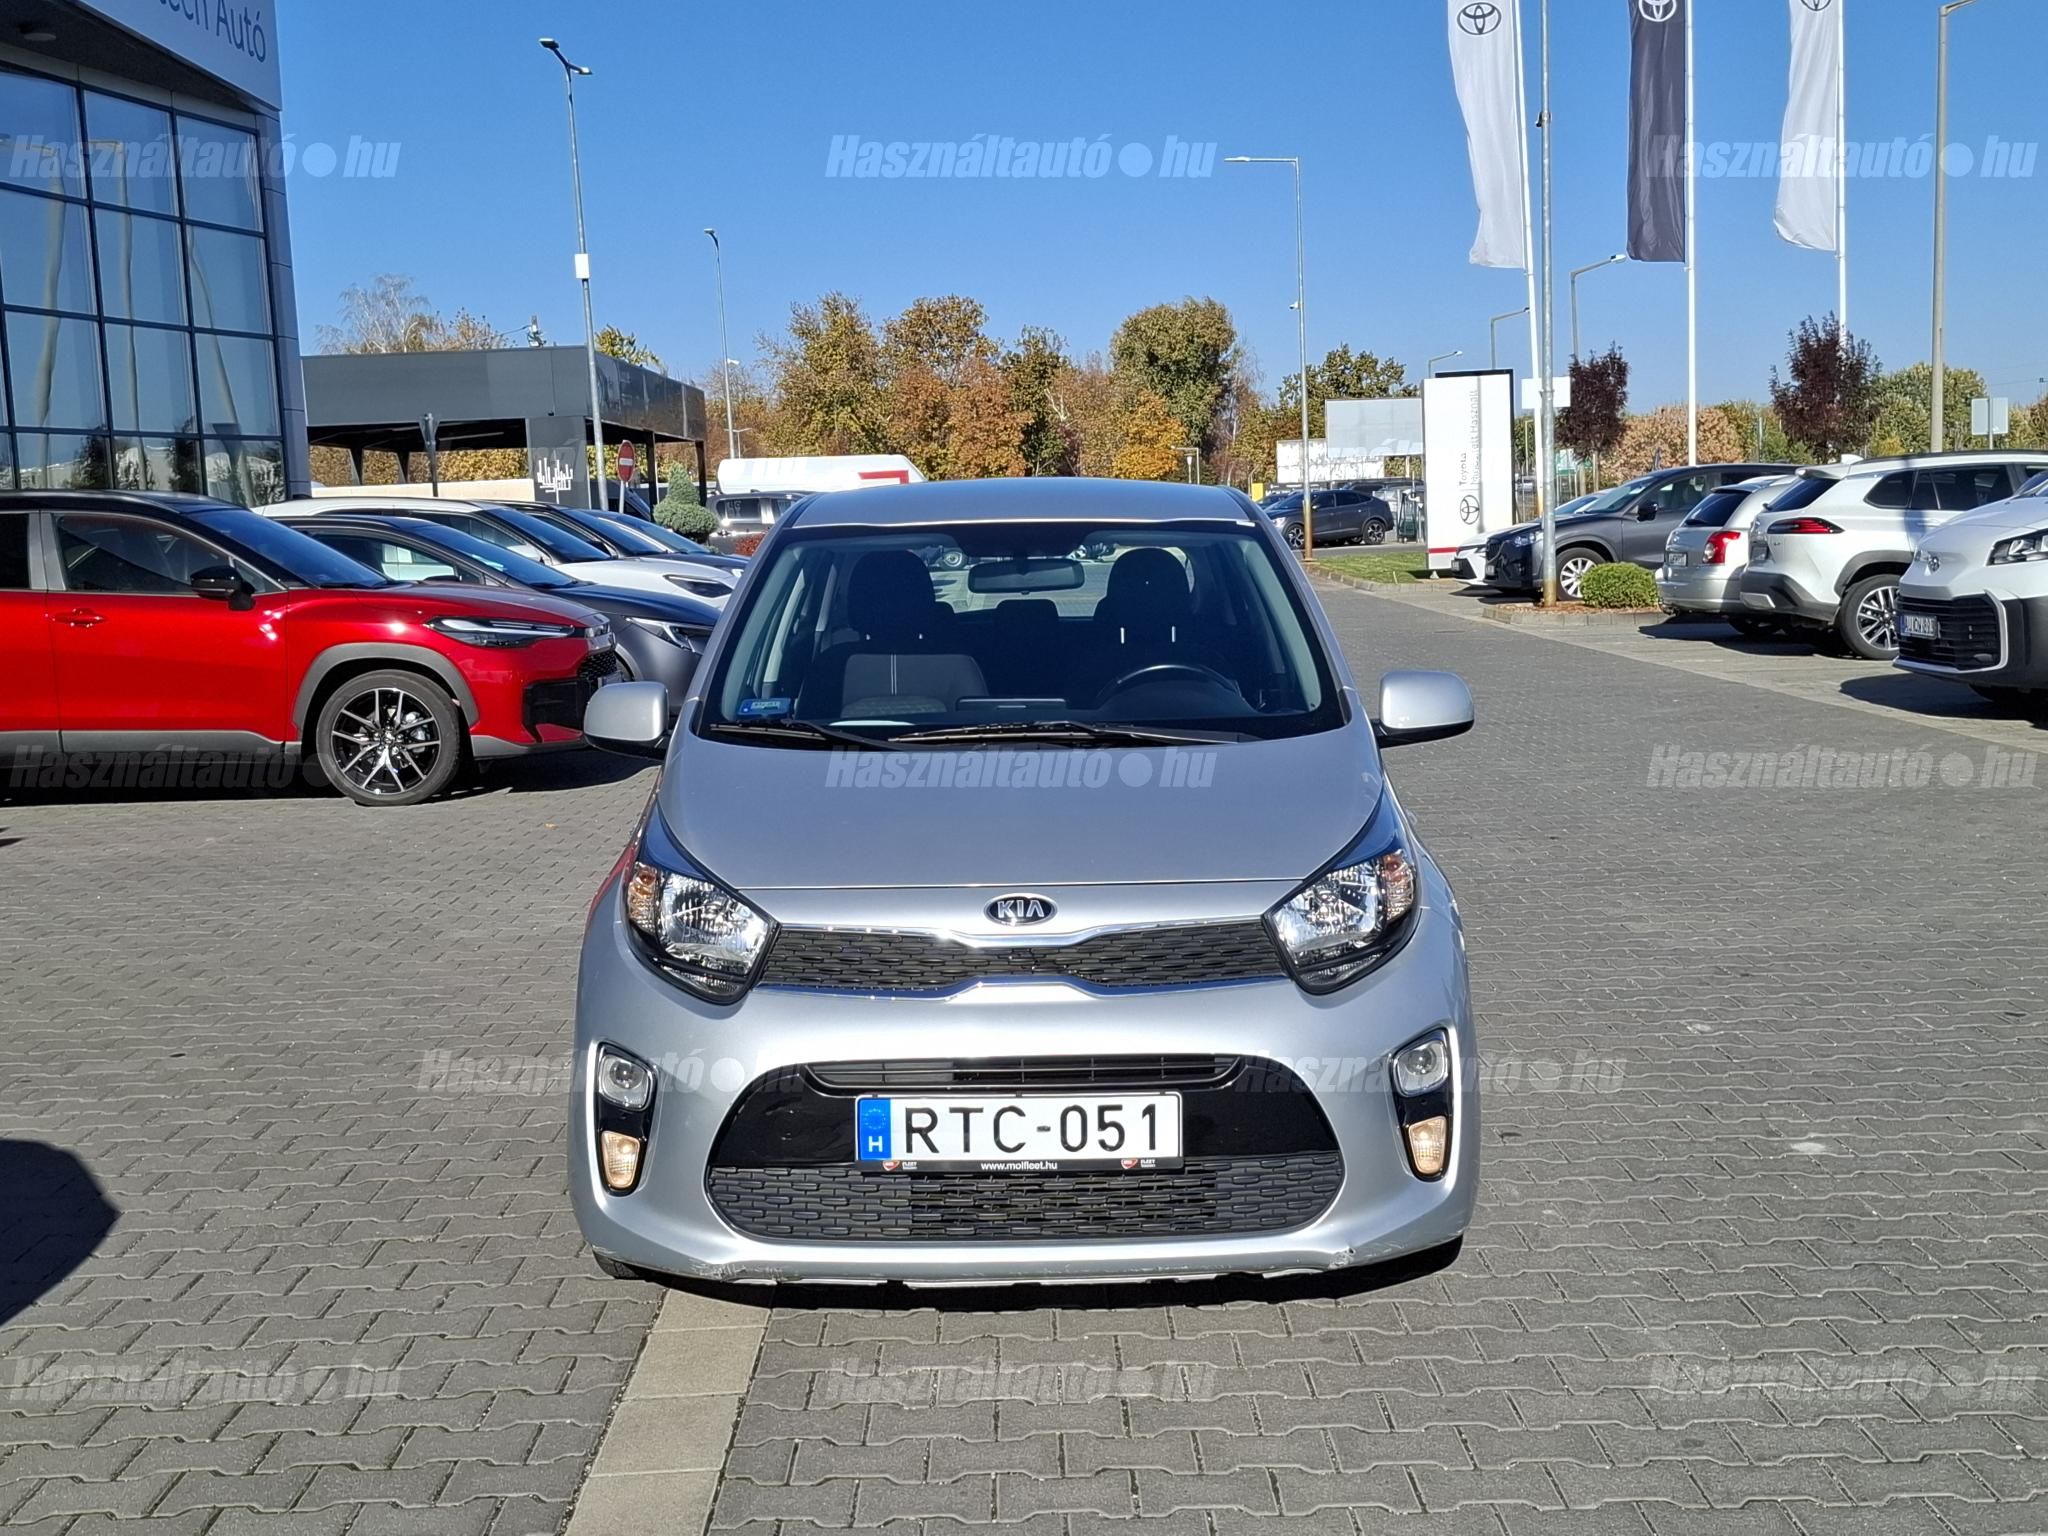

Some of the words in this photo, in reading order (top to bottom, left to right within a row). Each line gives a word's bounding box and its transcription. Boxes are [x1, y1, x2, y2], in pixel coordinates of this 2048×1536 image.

[216, 0, 266, 62] Autó
[997, 900, 1045, 918] KIA
[905, 1104, 1157, 1153] RTC-051
[868, 1135, 883, 1152] H
[980, 1160, 1058, 1170] www.molfleet.hu
